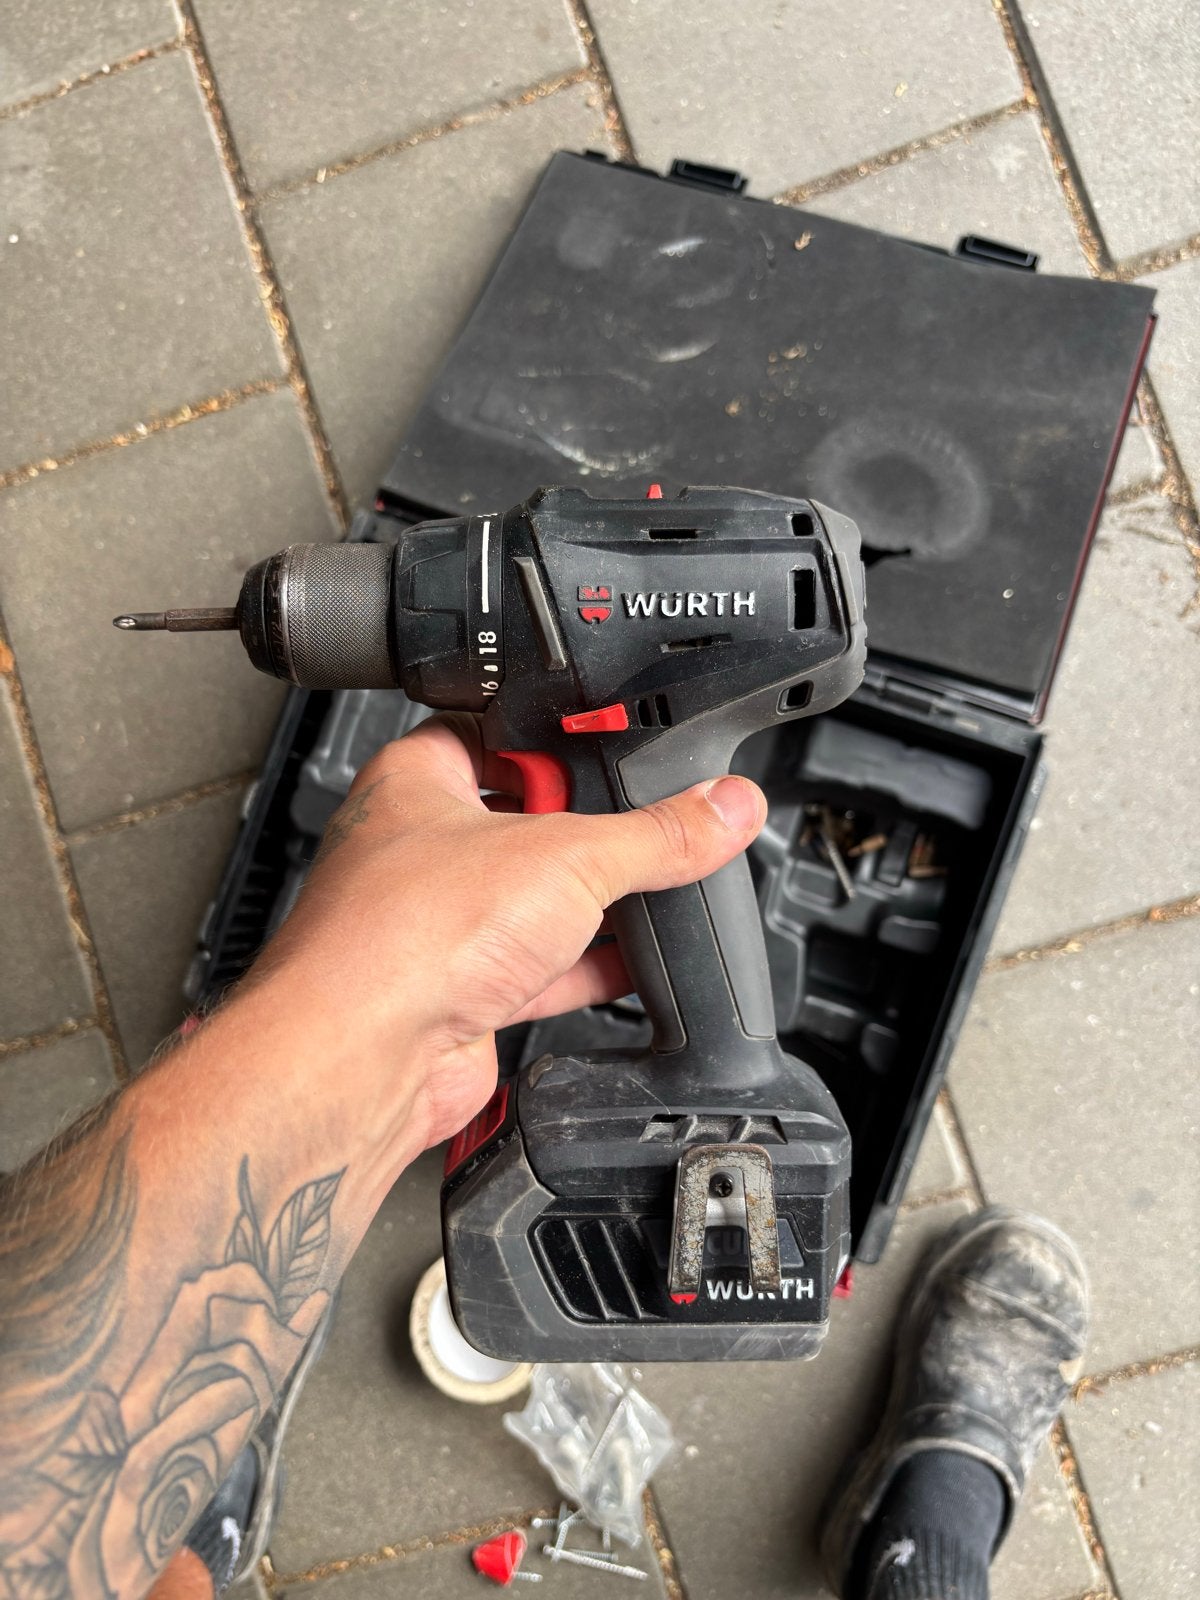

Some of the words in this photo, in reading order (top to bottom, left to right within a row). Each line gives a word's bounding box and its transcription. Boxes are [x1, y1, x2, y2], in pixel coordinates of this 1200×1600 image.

[623, 591, 756, 617] WÜRTH
[478, 630, 497, 656] 18
[481, 680, 499, 696] 16
